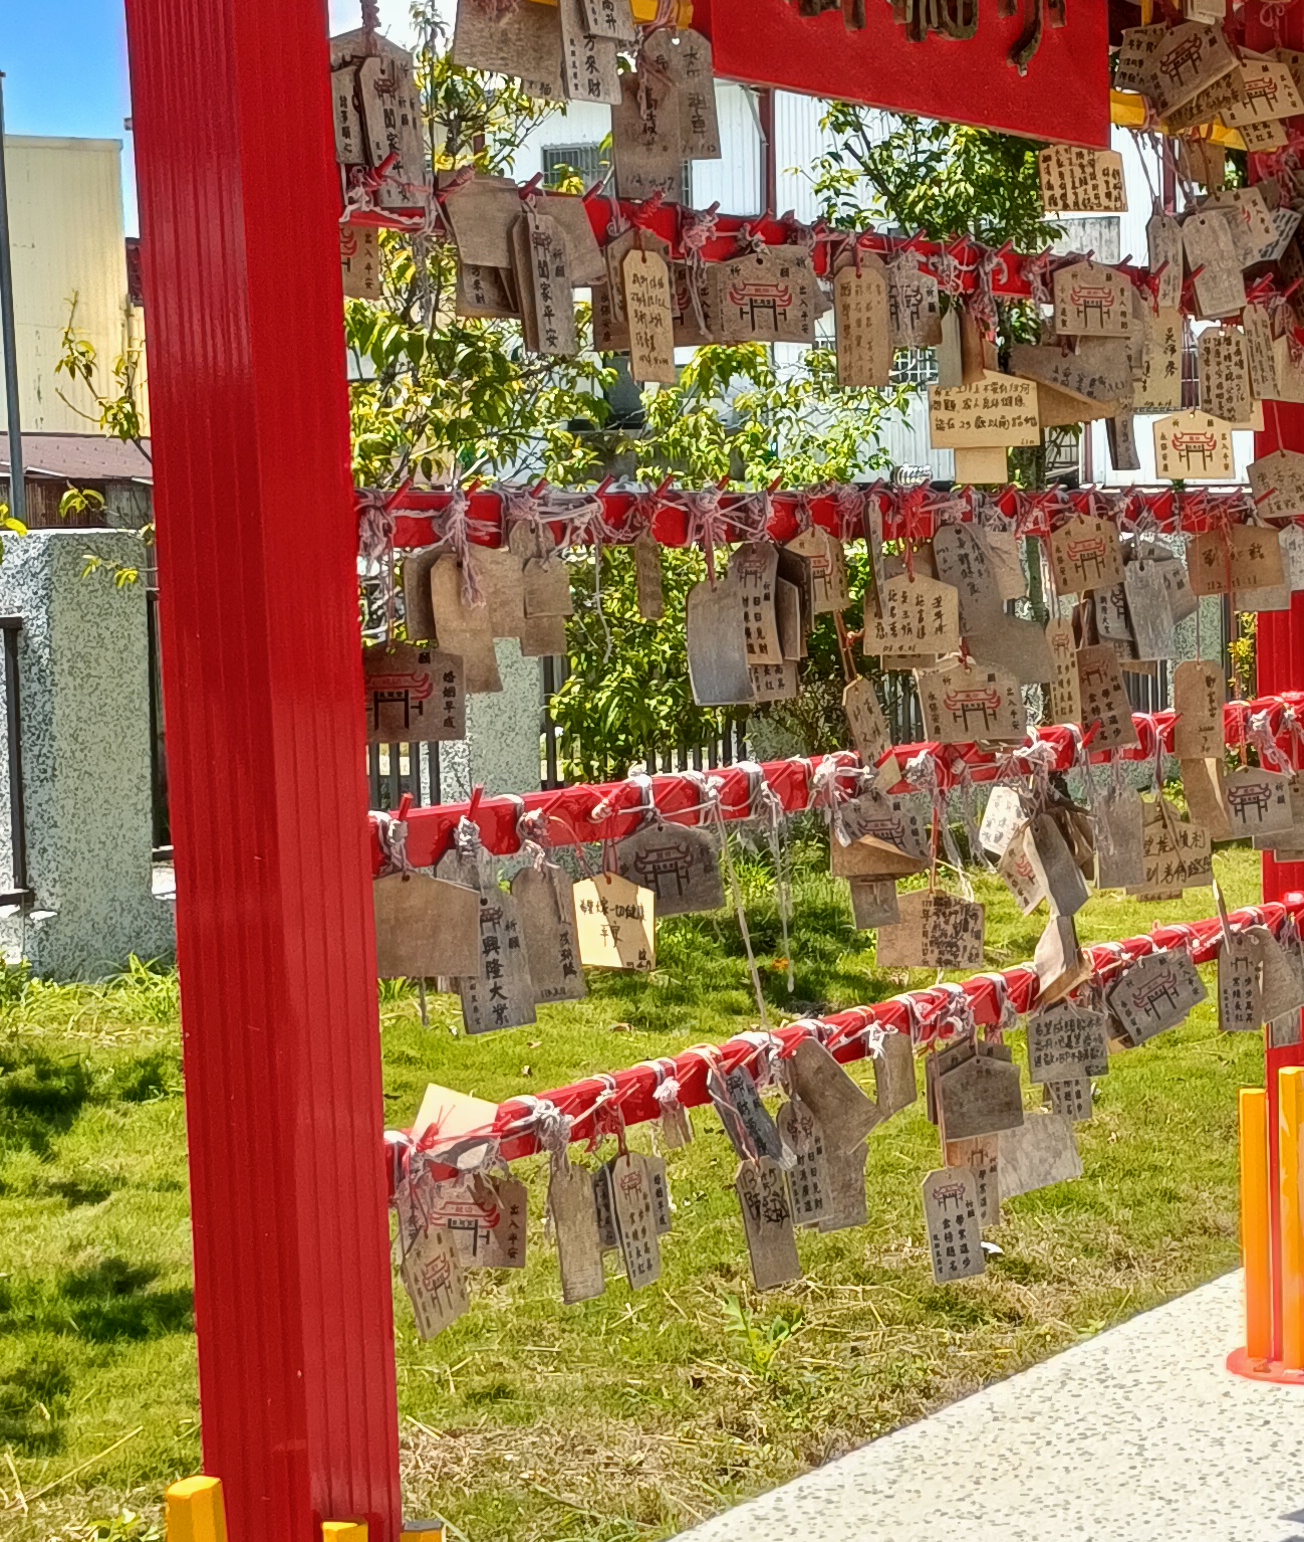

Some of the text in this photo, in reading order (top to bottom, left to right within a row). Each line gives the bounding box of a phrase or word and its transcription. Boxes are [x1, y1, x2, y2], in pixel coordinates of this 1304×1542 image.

[583, 31, 602, 98] 方來財
[363, 232, 375, 291] 出入平安
[552, 248, 566, 278] 祈願
[471, 265, 487, 306] 方來財
[925, 286, 937, 313] 祈願
[799, 285, 809, 334] 出入平安
[1160, 433, 1169, 472] 永保安康
[1221, 433, 1230, 471] 出入平安
[753, 596, 768, 655] 日日見財
[928, 691, 942, 735] 永保安康
[1006, 687, 1020, 731] 出入平安
[1275, 781, 1286, 805] 祈願
[505, 920, 521, 950] 祈願
[1244, 976, 1254, 1023] 步步高昇
[808, 1151, 823, 1210] 日日見財
[508, 1204, 519, 1260] 出入平安
[956, 1213, 971, 1269] 學業進步
